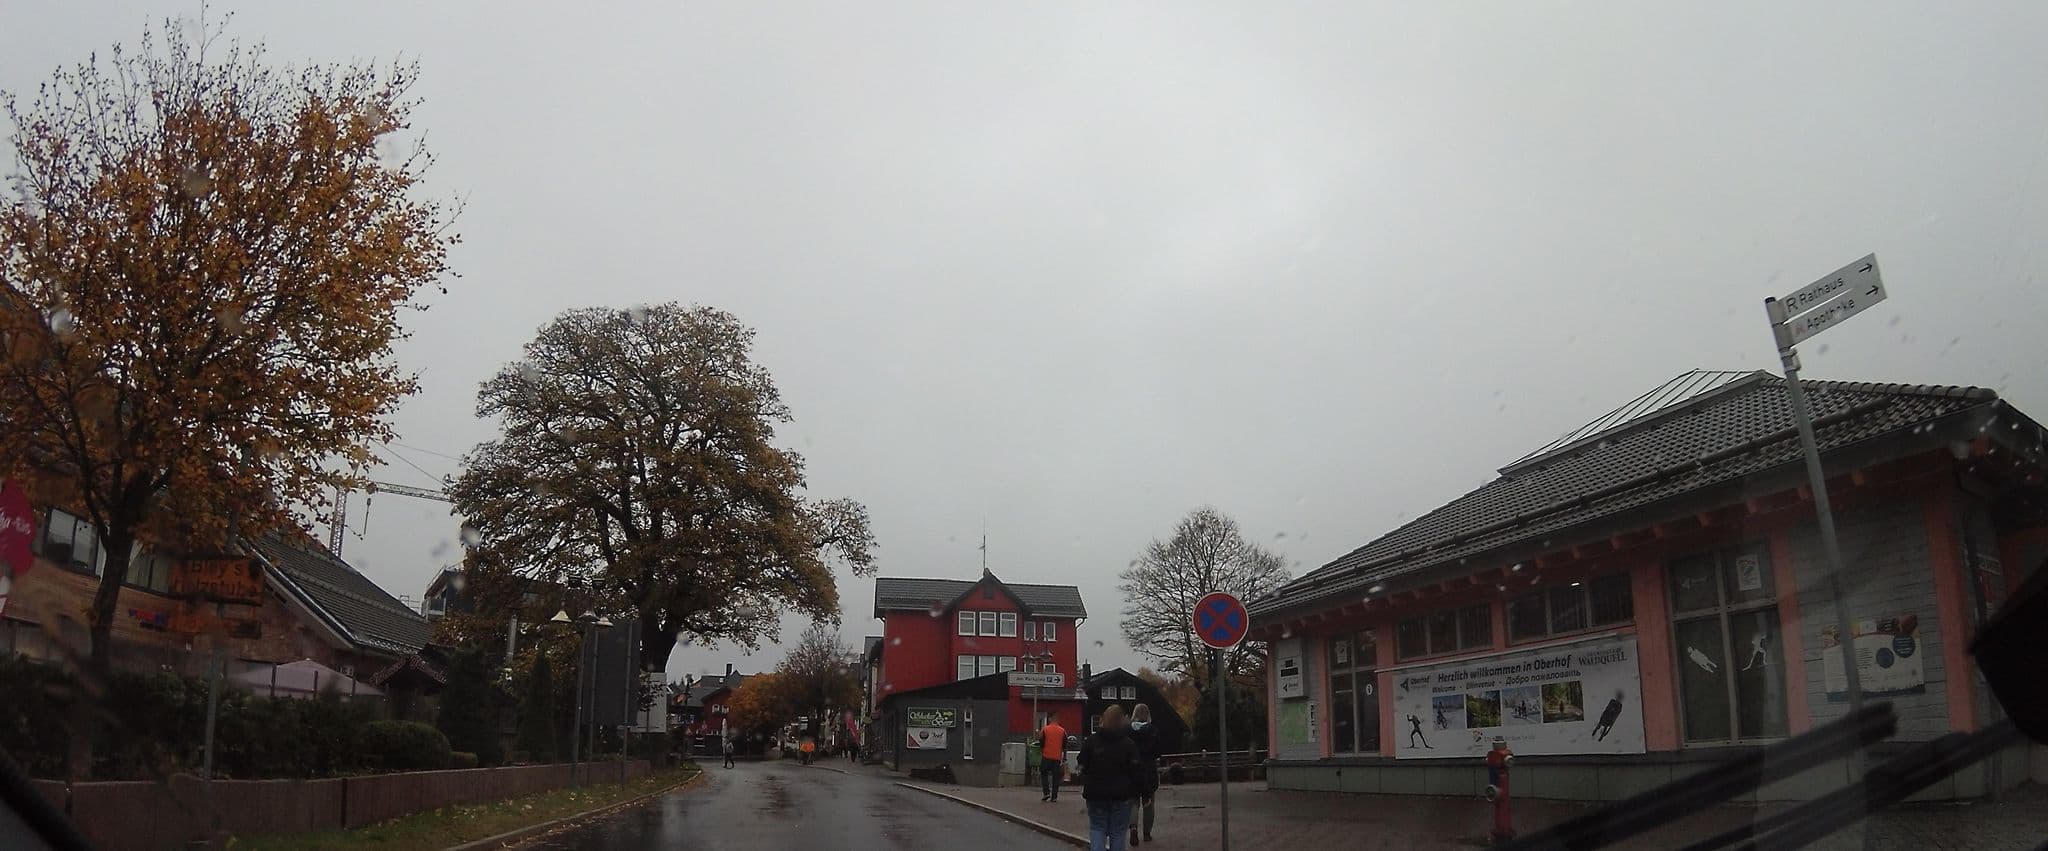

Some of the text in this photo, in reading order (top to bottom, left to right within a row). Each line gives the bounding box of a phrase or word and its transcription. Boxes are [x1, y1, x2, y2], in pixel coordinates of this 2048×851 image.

[1799, 277, 1844, 306] Rathaus
[1438, 654, 1572, 683] Herzlich willkommen in Oberhof
